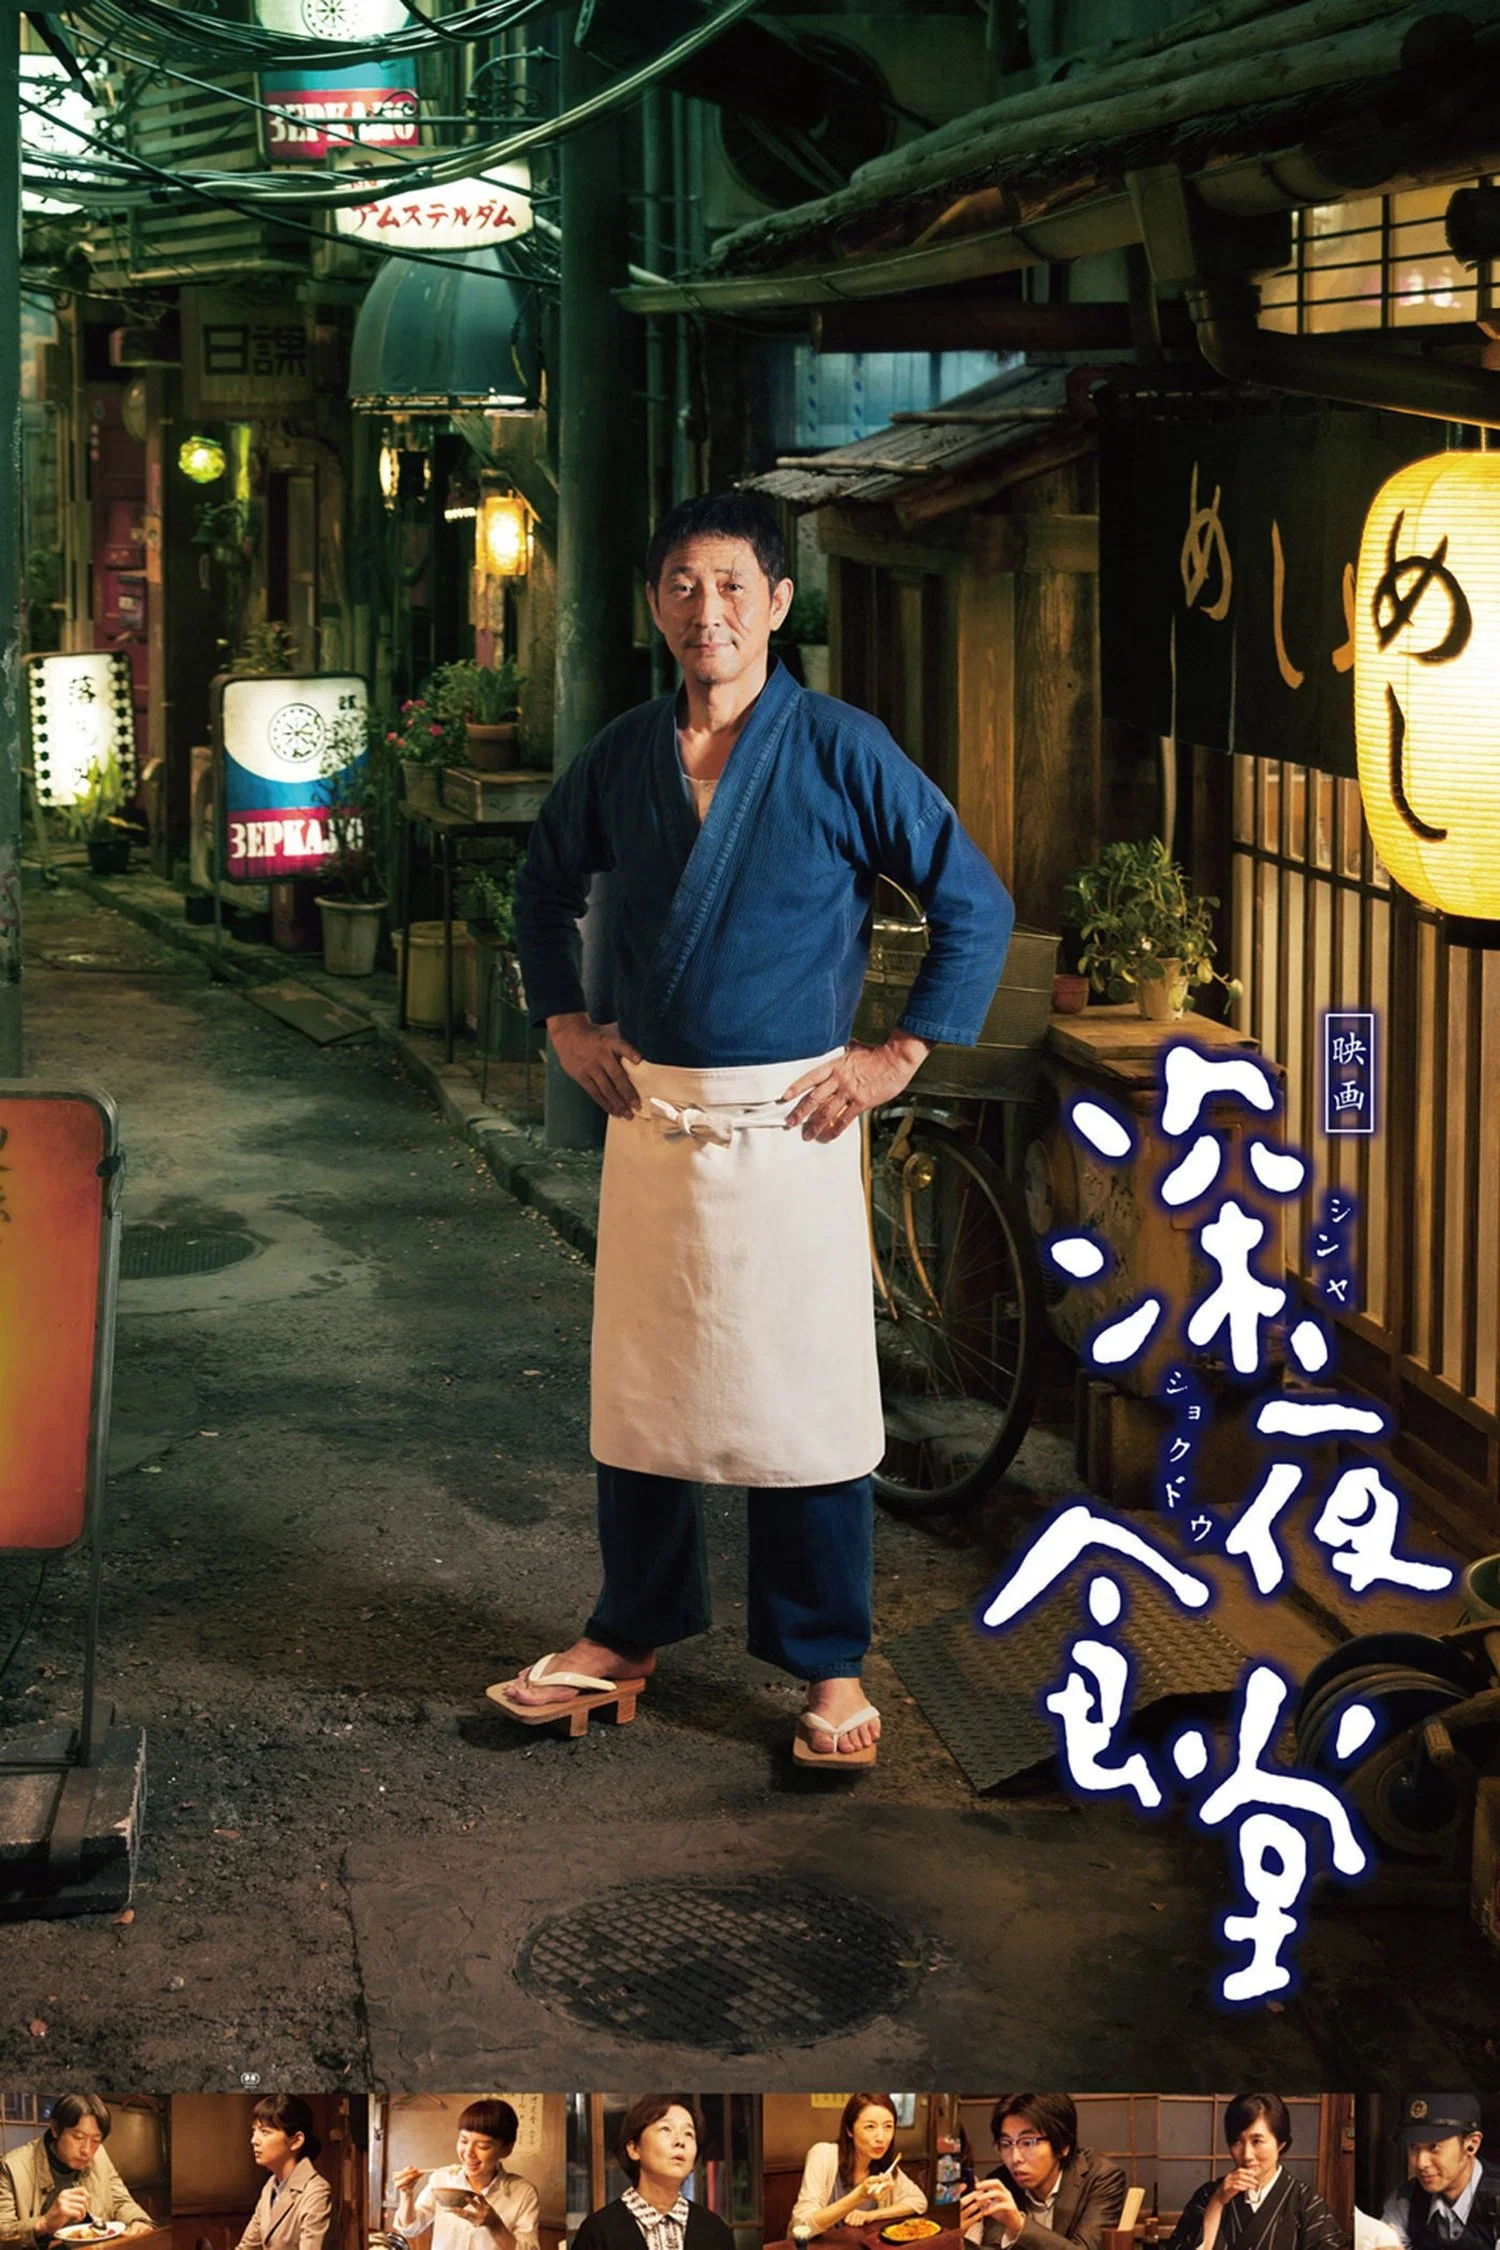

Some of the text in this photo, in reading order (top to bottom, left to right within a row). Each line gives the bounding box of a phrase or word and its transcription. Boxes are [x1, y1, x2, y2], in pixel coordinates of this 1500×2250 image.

[351, 199, 517, 230] アムステルダム
[1371, 509, 1473, 843] めし
